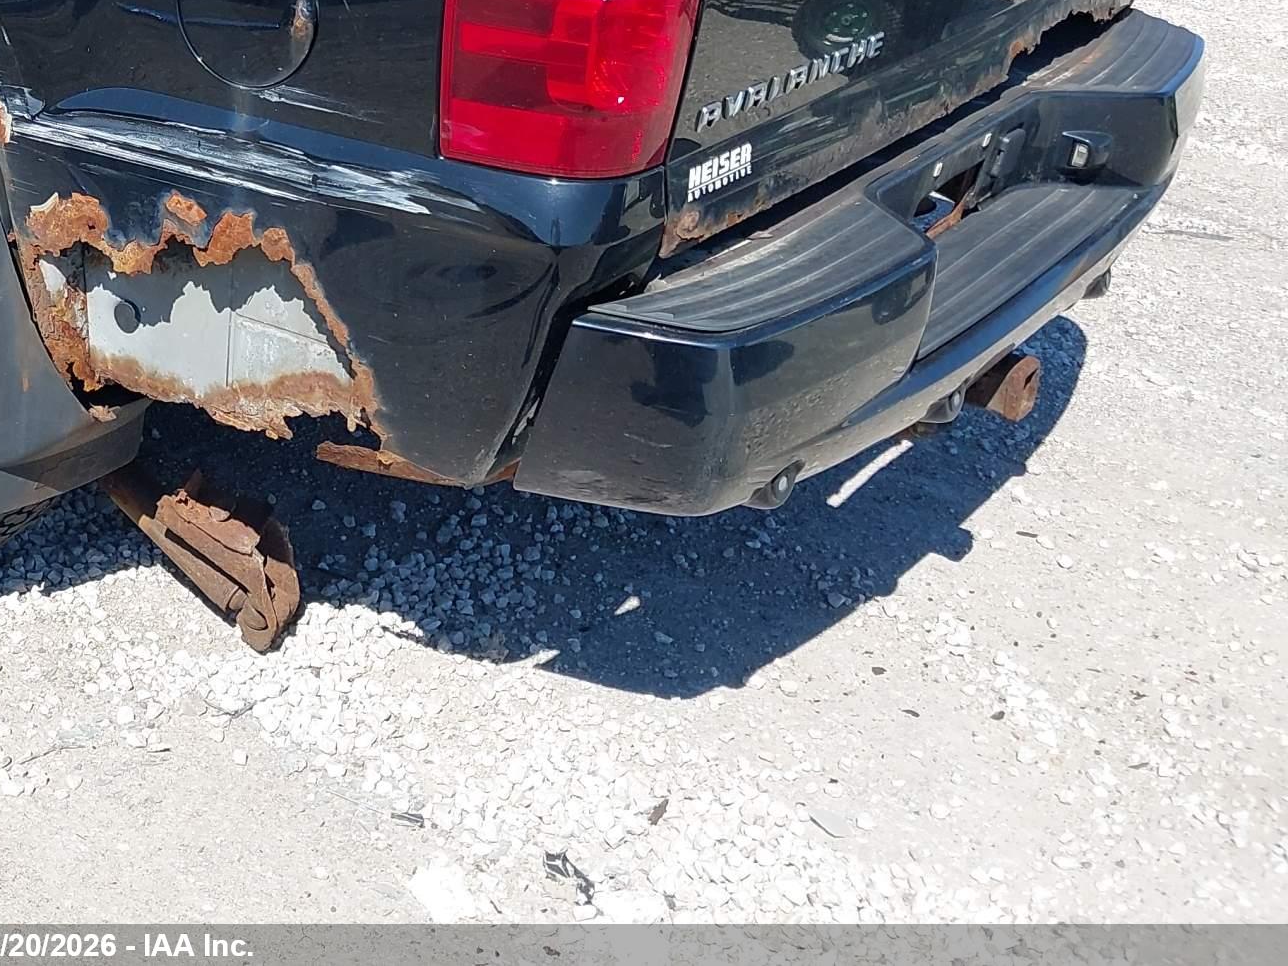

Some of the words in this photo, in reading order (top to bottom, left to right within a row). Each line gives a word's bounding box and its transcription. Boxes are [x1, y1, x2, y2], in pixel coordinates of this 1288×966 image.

[696, 31, 886, 133] AVALANCHE
[686, 164, 753, 203] AUTOMOTIVE
[688, 142, 753, 190] HEISER
